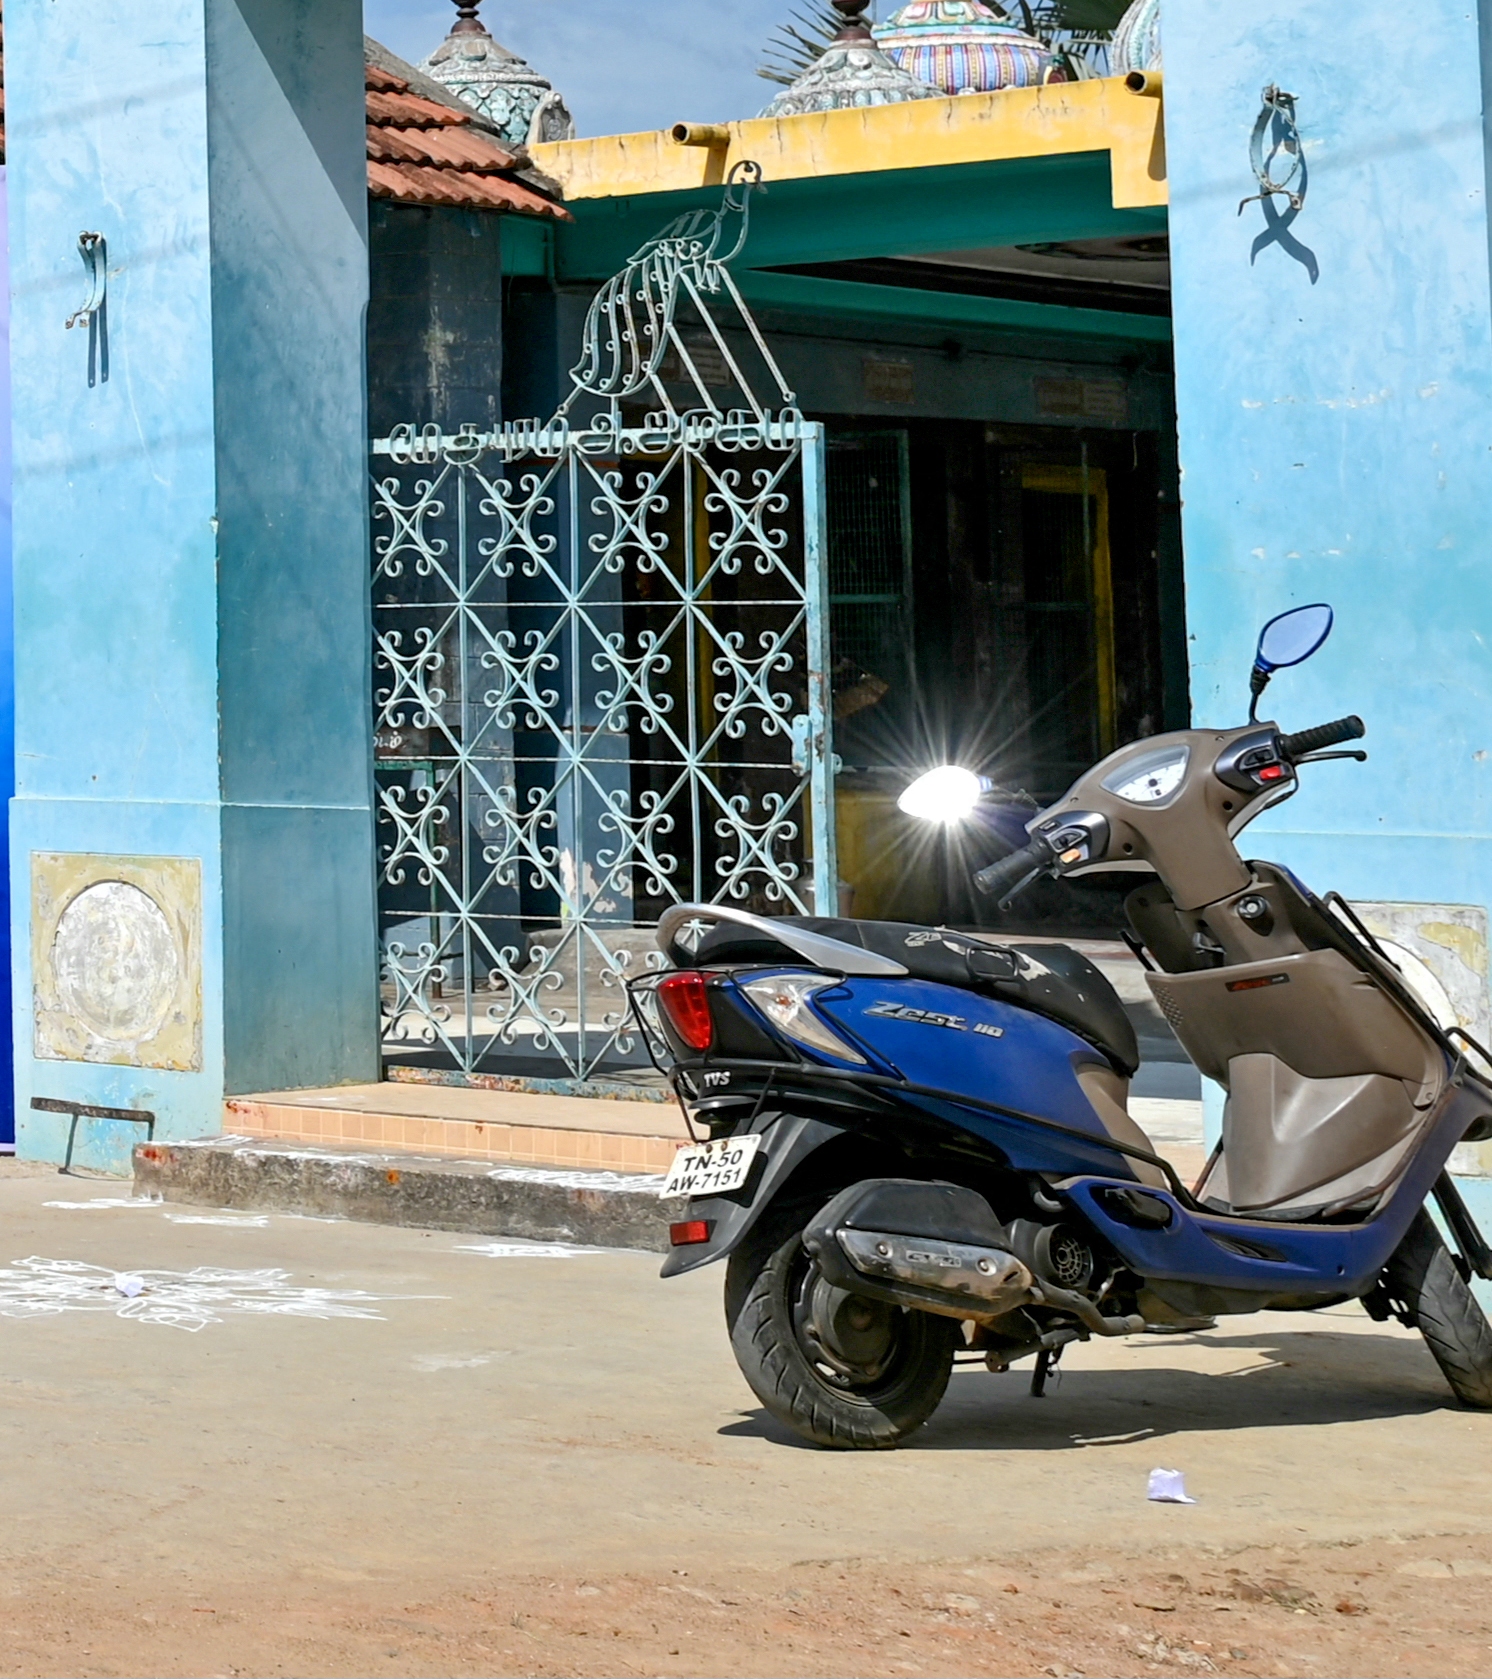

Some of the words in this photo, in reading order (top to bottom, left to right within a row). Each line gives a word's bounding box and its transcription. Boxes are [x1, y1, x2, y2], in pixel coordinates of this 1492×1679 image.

[704, 1071, 731, 1088] TVS
[684, 1149, 744, 1172] TN-50
[666, 1167, 742, 1194] AW-7151
